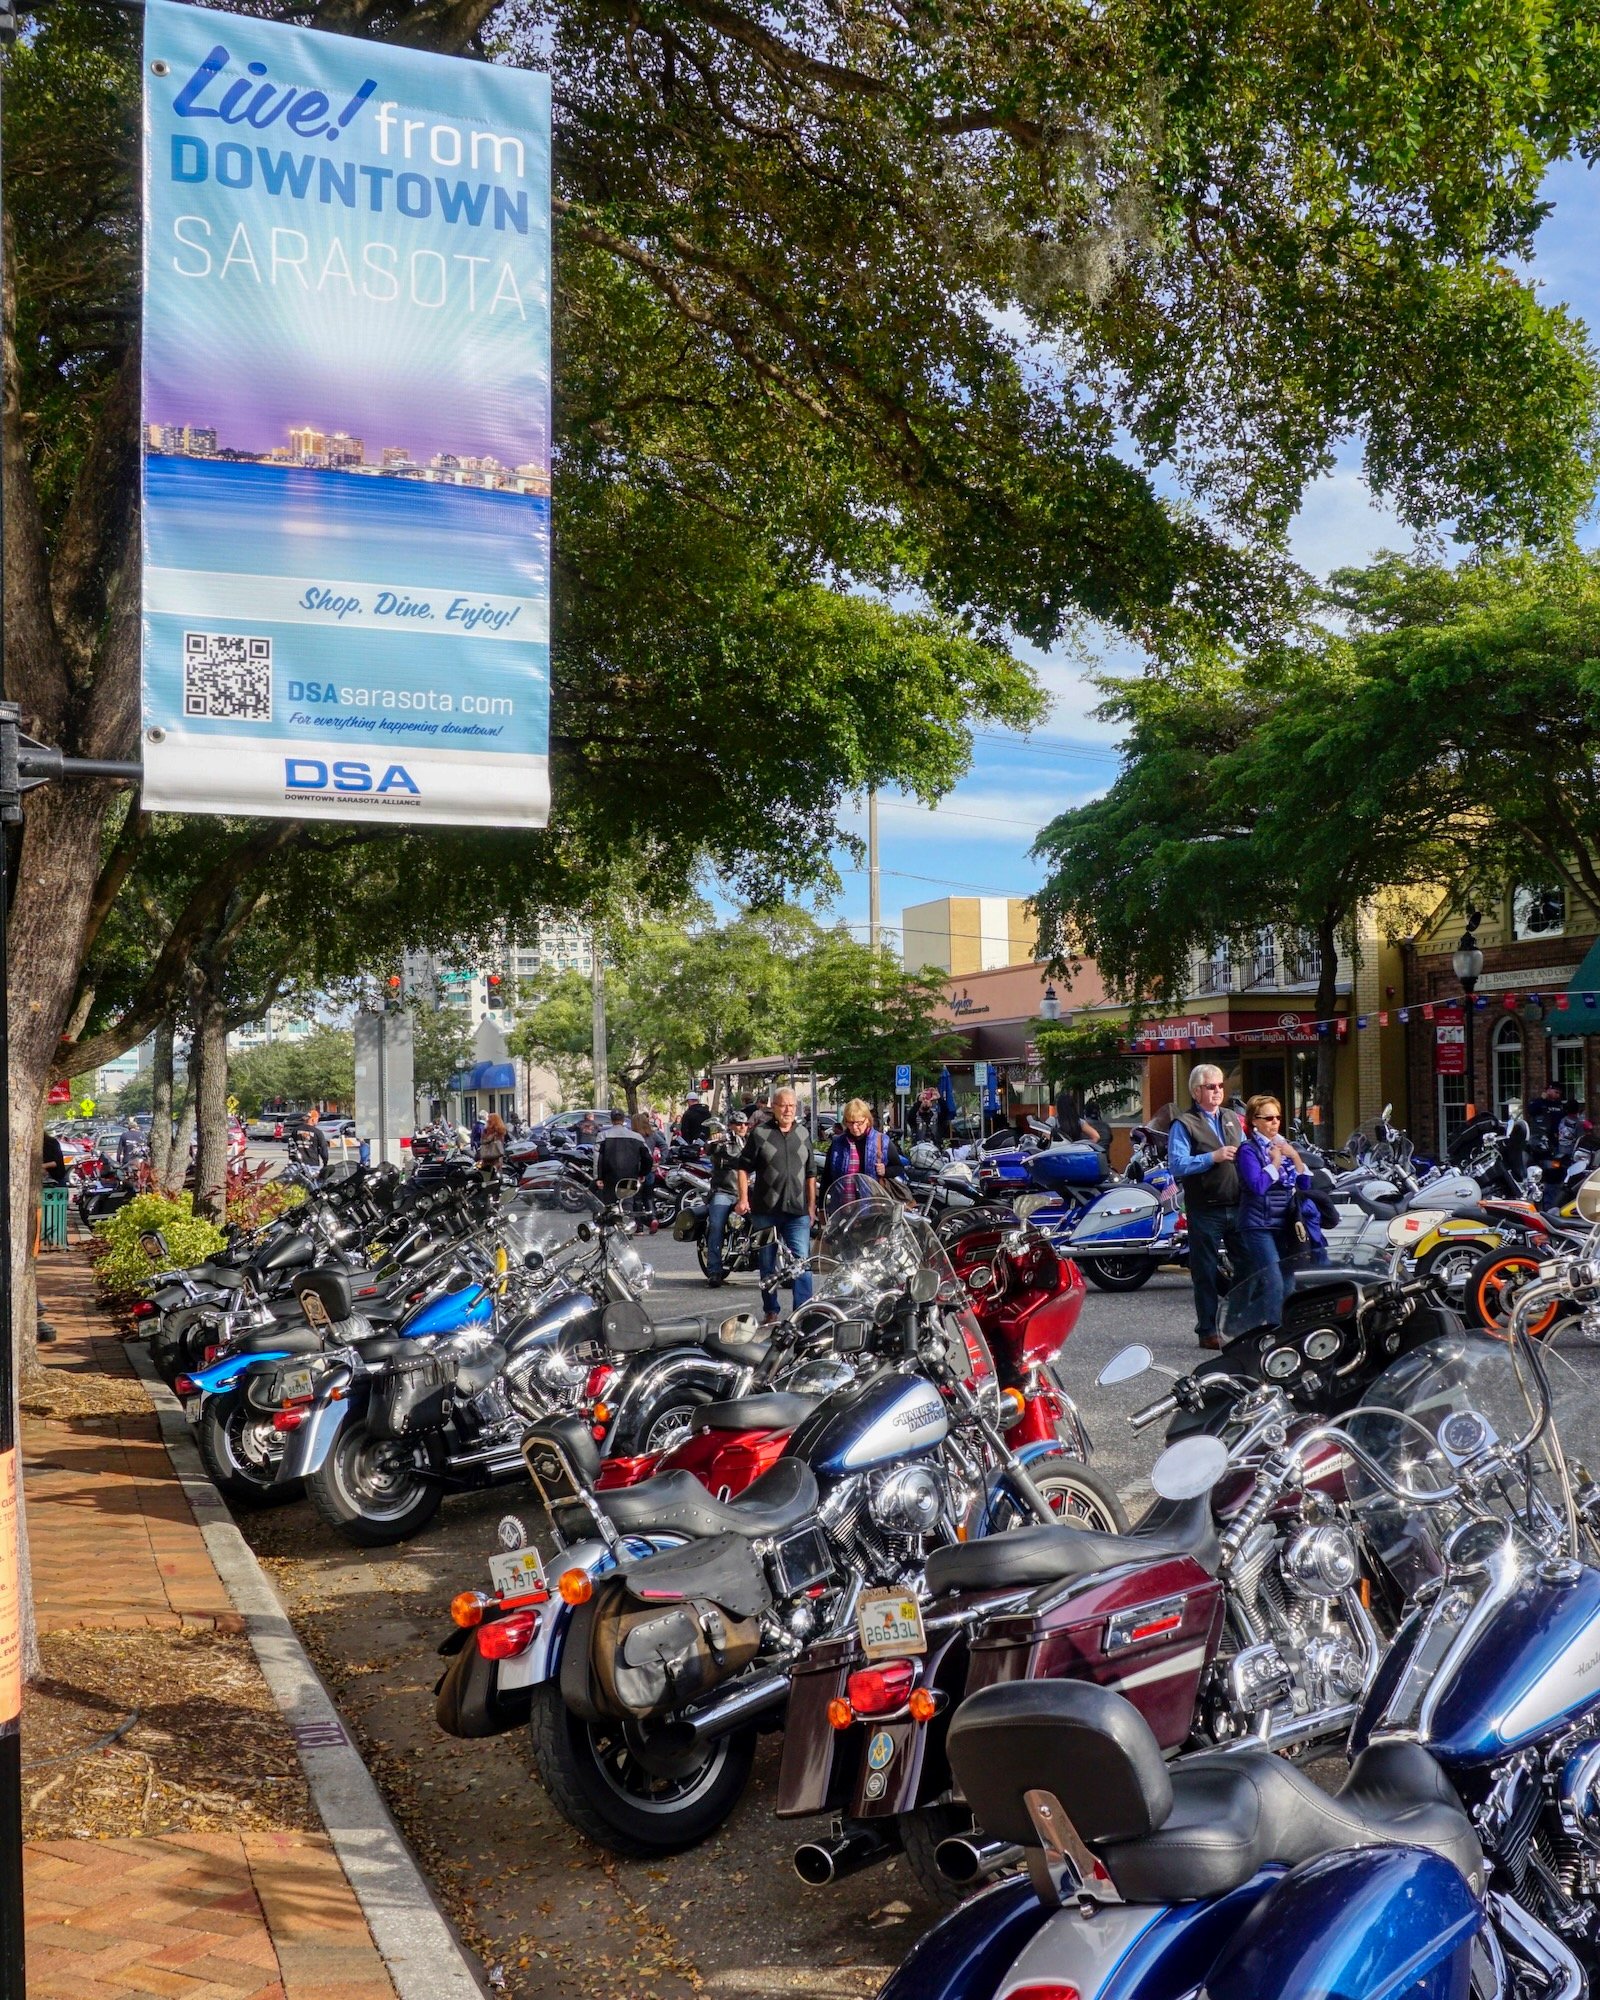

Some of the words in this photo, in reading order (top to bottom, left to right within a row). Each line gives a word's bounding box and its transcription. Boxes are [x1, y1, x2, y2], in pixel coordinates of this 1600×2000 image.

[172, 45, 377, 141] Live!
[374, 101, 525, 178] from
[171, 134, 529, 235] DOWNTOWN
[172, 216, 527, 321] SARASOTA
[299, 587, 363, 620] Shop.
[373, 592, 435, 619] Dine.
[445, 598, 521, 631] Enjoy!
[288, 681, 513, 716] DSAsarasota.com
[289, 711, 311, 724] For
[313, 716, 377, 732] everything
[378, 718, 439, 735] happening
[441, 721, 504, 737] downtown!
[285, 758, 421, 794] DSA
[285, 794, 335, 802] DOWNTOWN
[337, 796, 380, 805] SARASOTA
[1536, 969, 1554, 978] AND
[1158, 1022, 1190, 1038] National
[1191, 1021, 1214, 1037] Trust
[866, 1621, 916, 1642] 26633L
